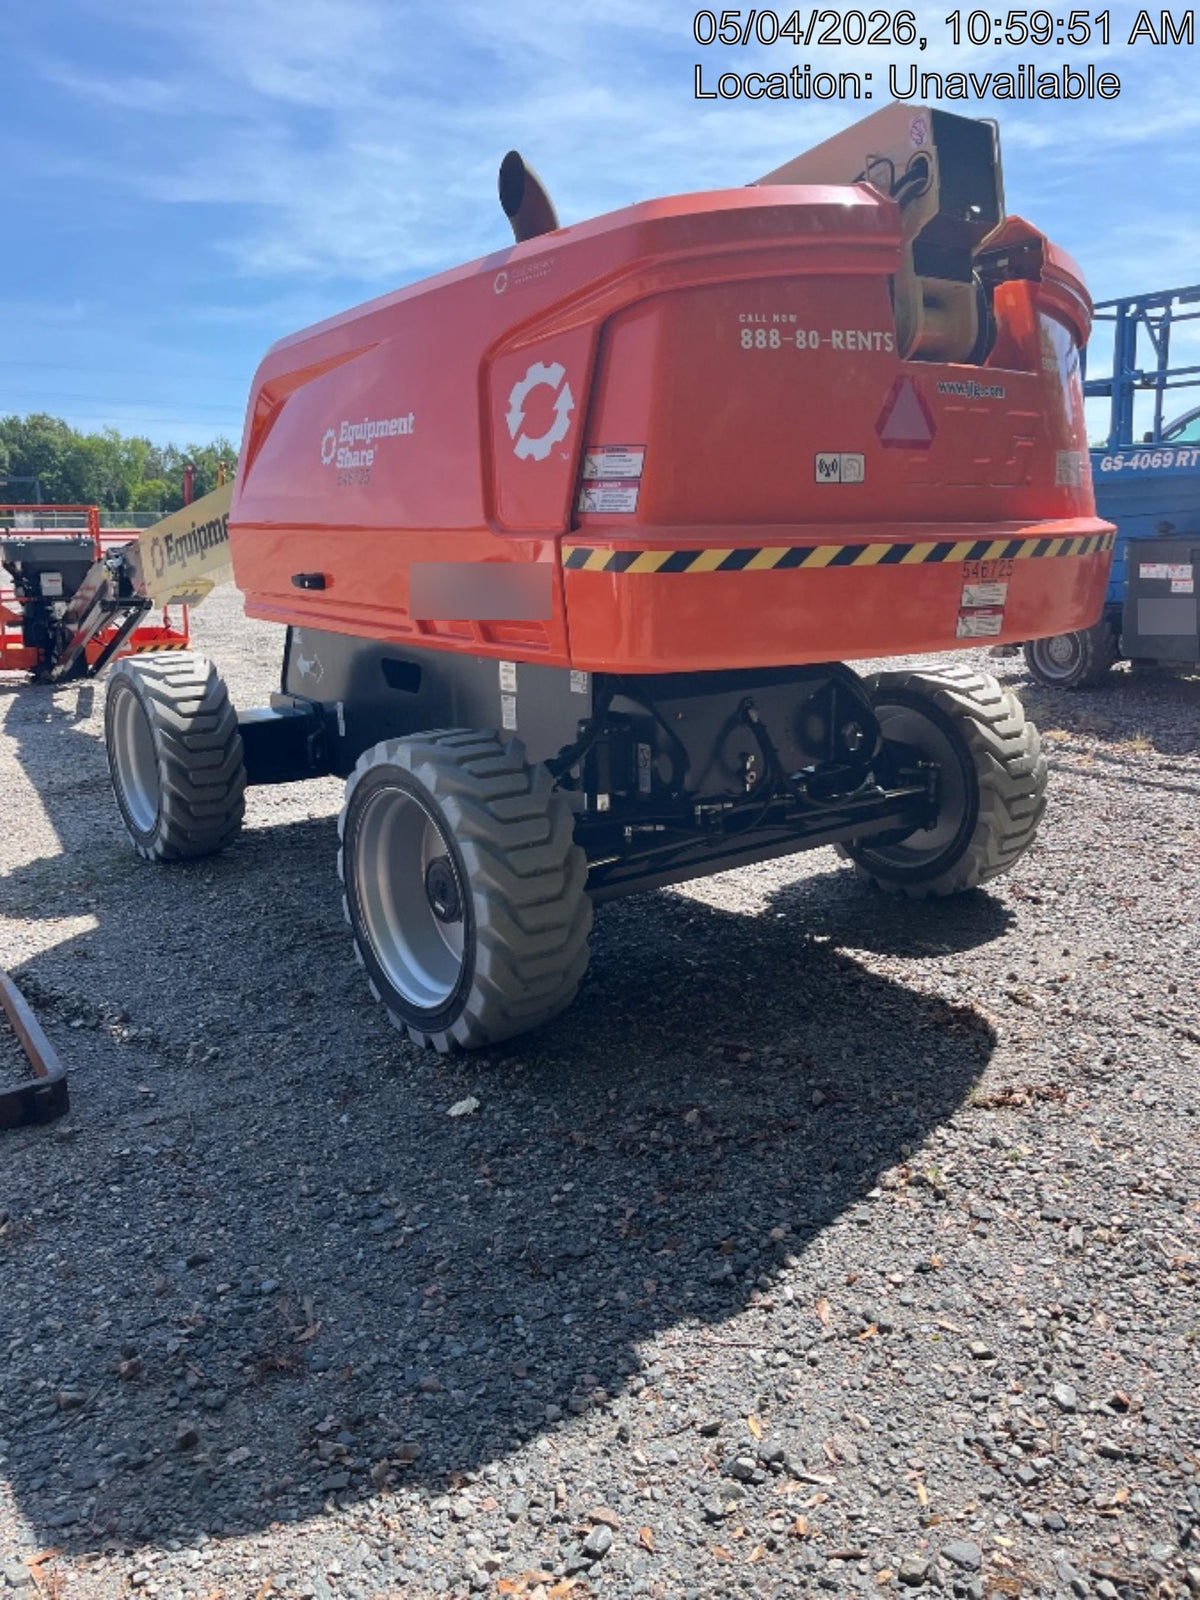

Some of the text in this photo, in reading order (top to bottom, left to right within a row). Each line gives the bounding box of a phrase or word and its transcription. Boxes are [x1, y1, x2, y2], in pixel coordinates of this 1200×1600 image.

[739, 314, 797, 323] CALL NOW
[740, 328, 895, 352] 888-80-RENTS
[339, 412, 415, 446] Equipment
[336, 446, 374, 468] Share
[1100, 452, 1174, 472] GS-4069
[1175, 449, 1200, 467] RT
[962, 559, 1014, 578] 546725
